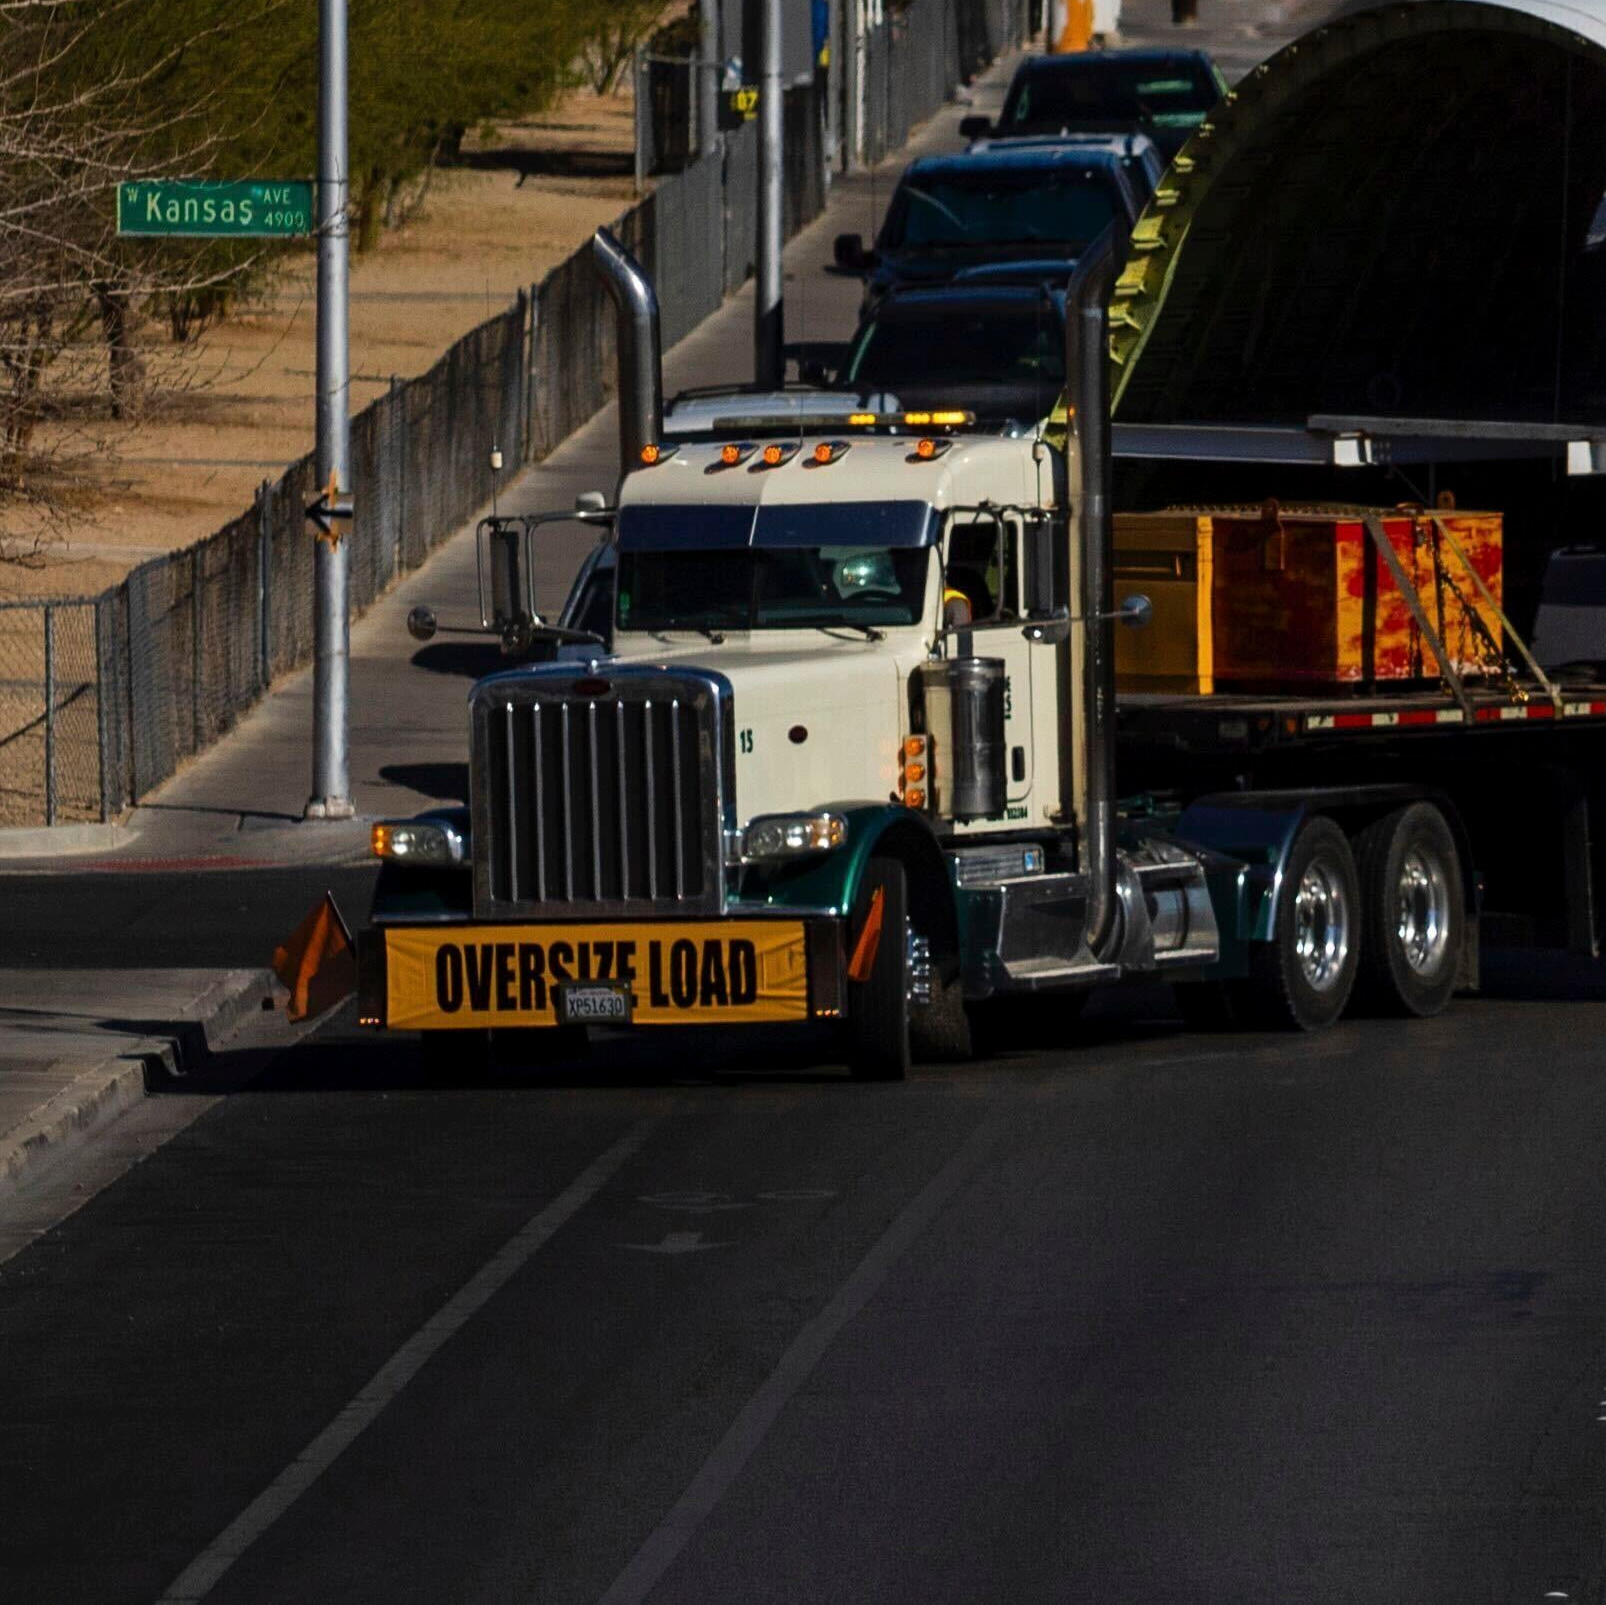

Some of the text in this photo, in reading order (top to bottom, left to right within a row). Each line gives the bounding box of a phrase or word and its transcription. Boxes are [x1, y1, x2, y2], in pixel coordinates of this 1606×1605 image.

[126, 187, 291, 224] W Kansas AVE
[264, 210, 305, 228] 4900
[739, 729, 754, 755] 15
[435, 937, 758, 1014] OVERSIZE LOAD
